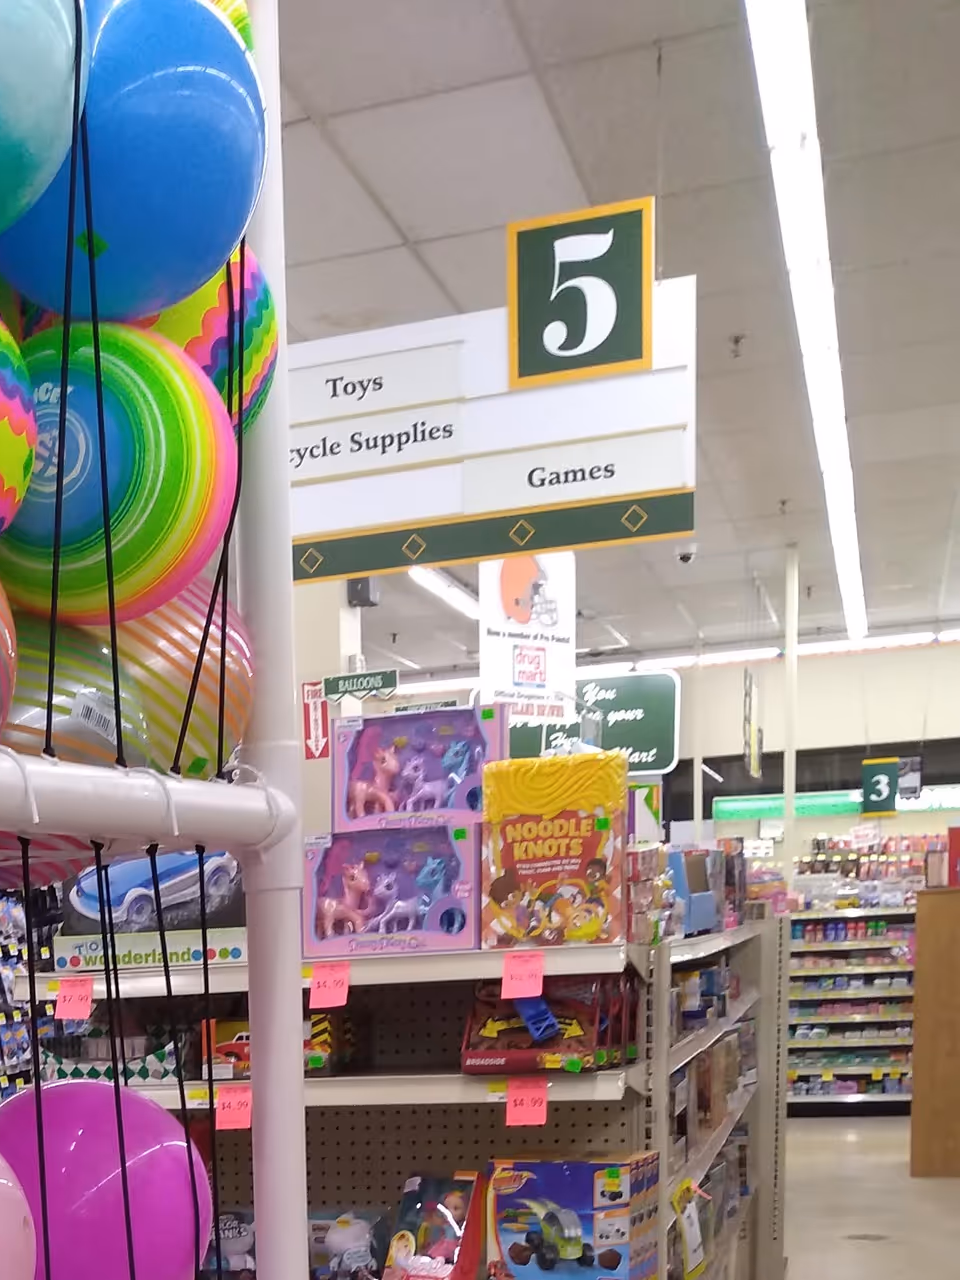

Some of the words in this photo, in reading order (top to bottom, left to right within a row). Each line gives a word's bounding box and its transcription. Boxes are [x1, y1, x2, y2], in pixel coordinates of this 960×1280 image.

[543, 228, 618, 357] 5
[325, 375, 384, 401] Toys
[349, 421, 454, 456] Supplies
[527, 463, 616, 489] Games
[516, 650, 540, 669] drug
[338, 675, 383, 691] BALLOONS
[518, 668, 546, 682] mart
[582, 682, 616, 706] You
[607, 706, 645, 727] your
[869, 774, 890, 802] 3
[505, 817, 593, 843] NOODLE
[513, 837, 584, 861] KNOTS
